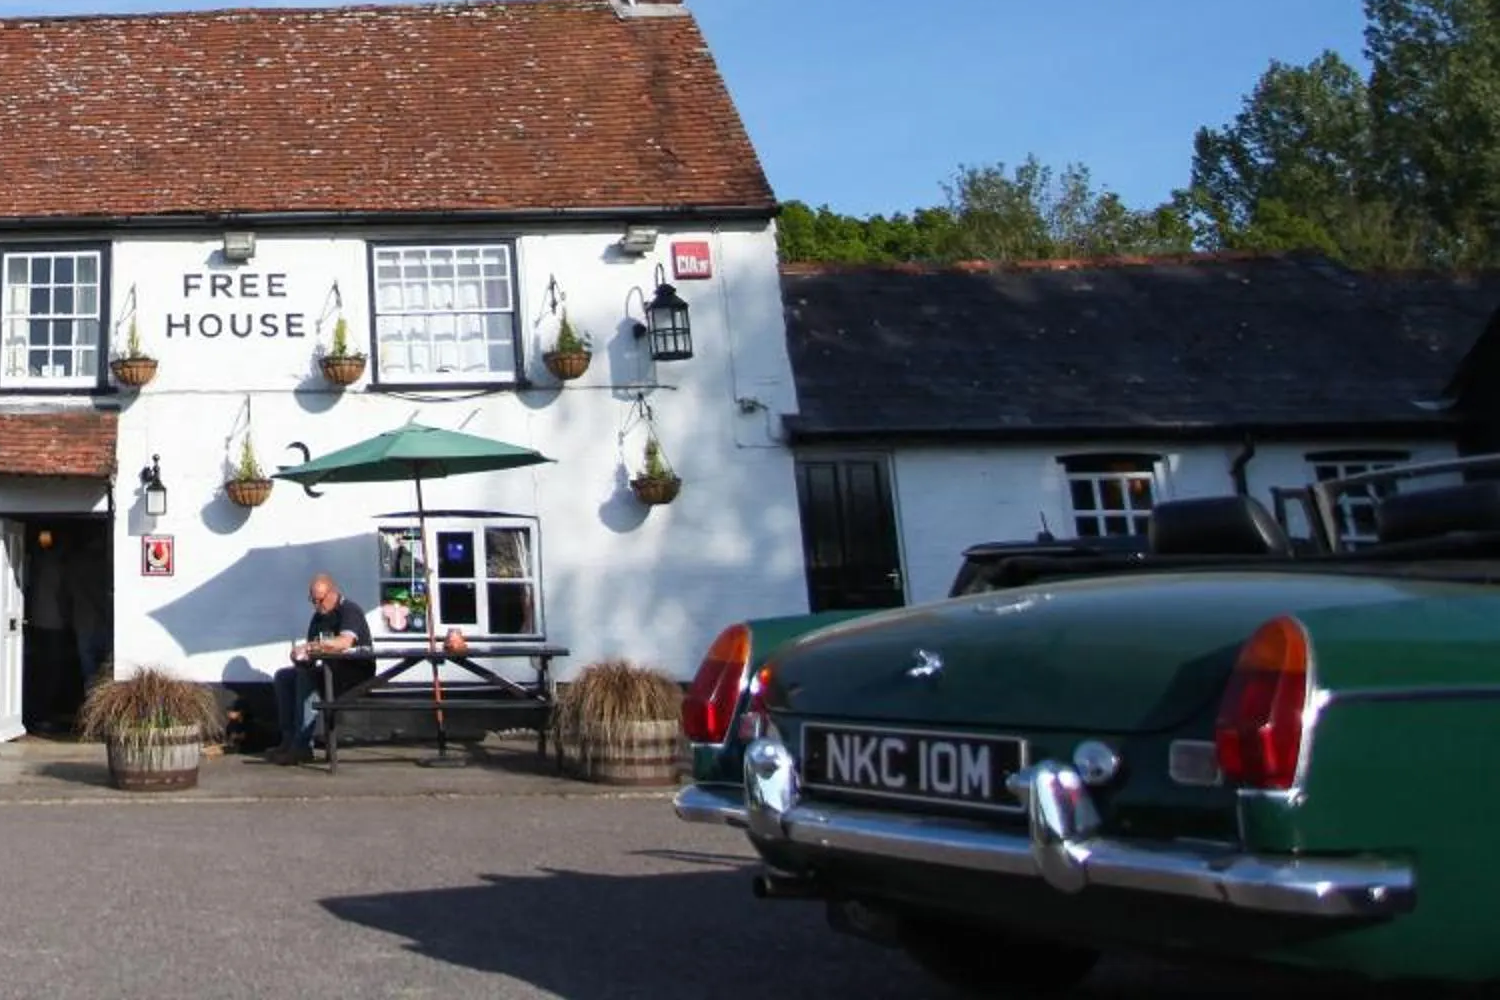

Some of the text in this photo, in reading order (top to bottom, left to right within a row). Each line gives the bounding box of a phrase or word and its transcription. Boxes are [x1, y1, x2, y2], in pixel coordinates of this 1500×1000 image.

[183, 273, 287, 298] FREE
[166, 313, 306, 338] HOUSE
[825, 732, 906, 788] NKC
